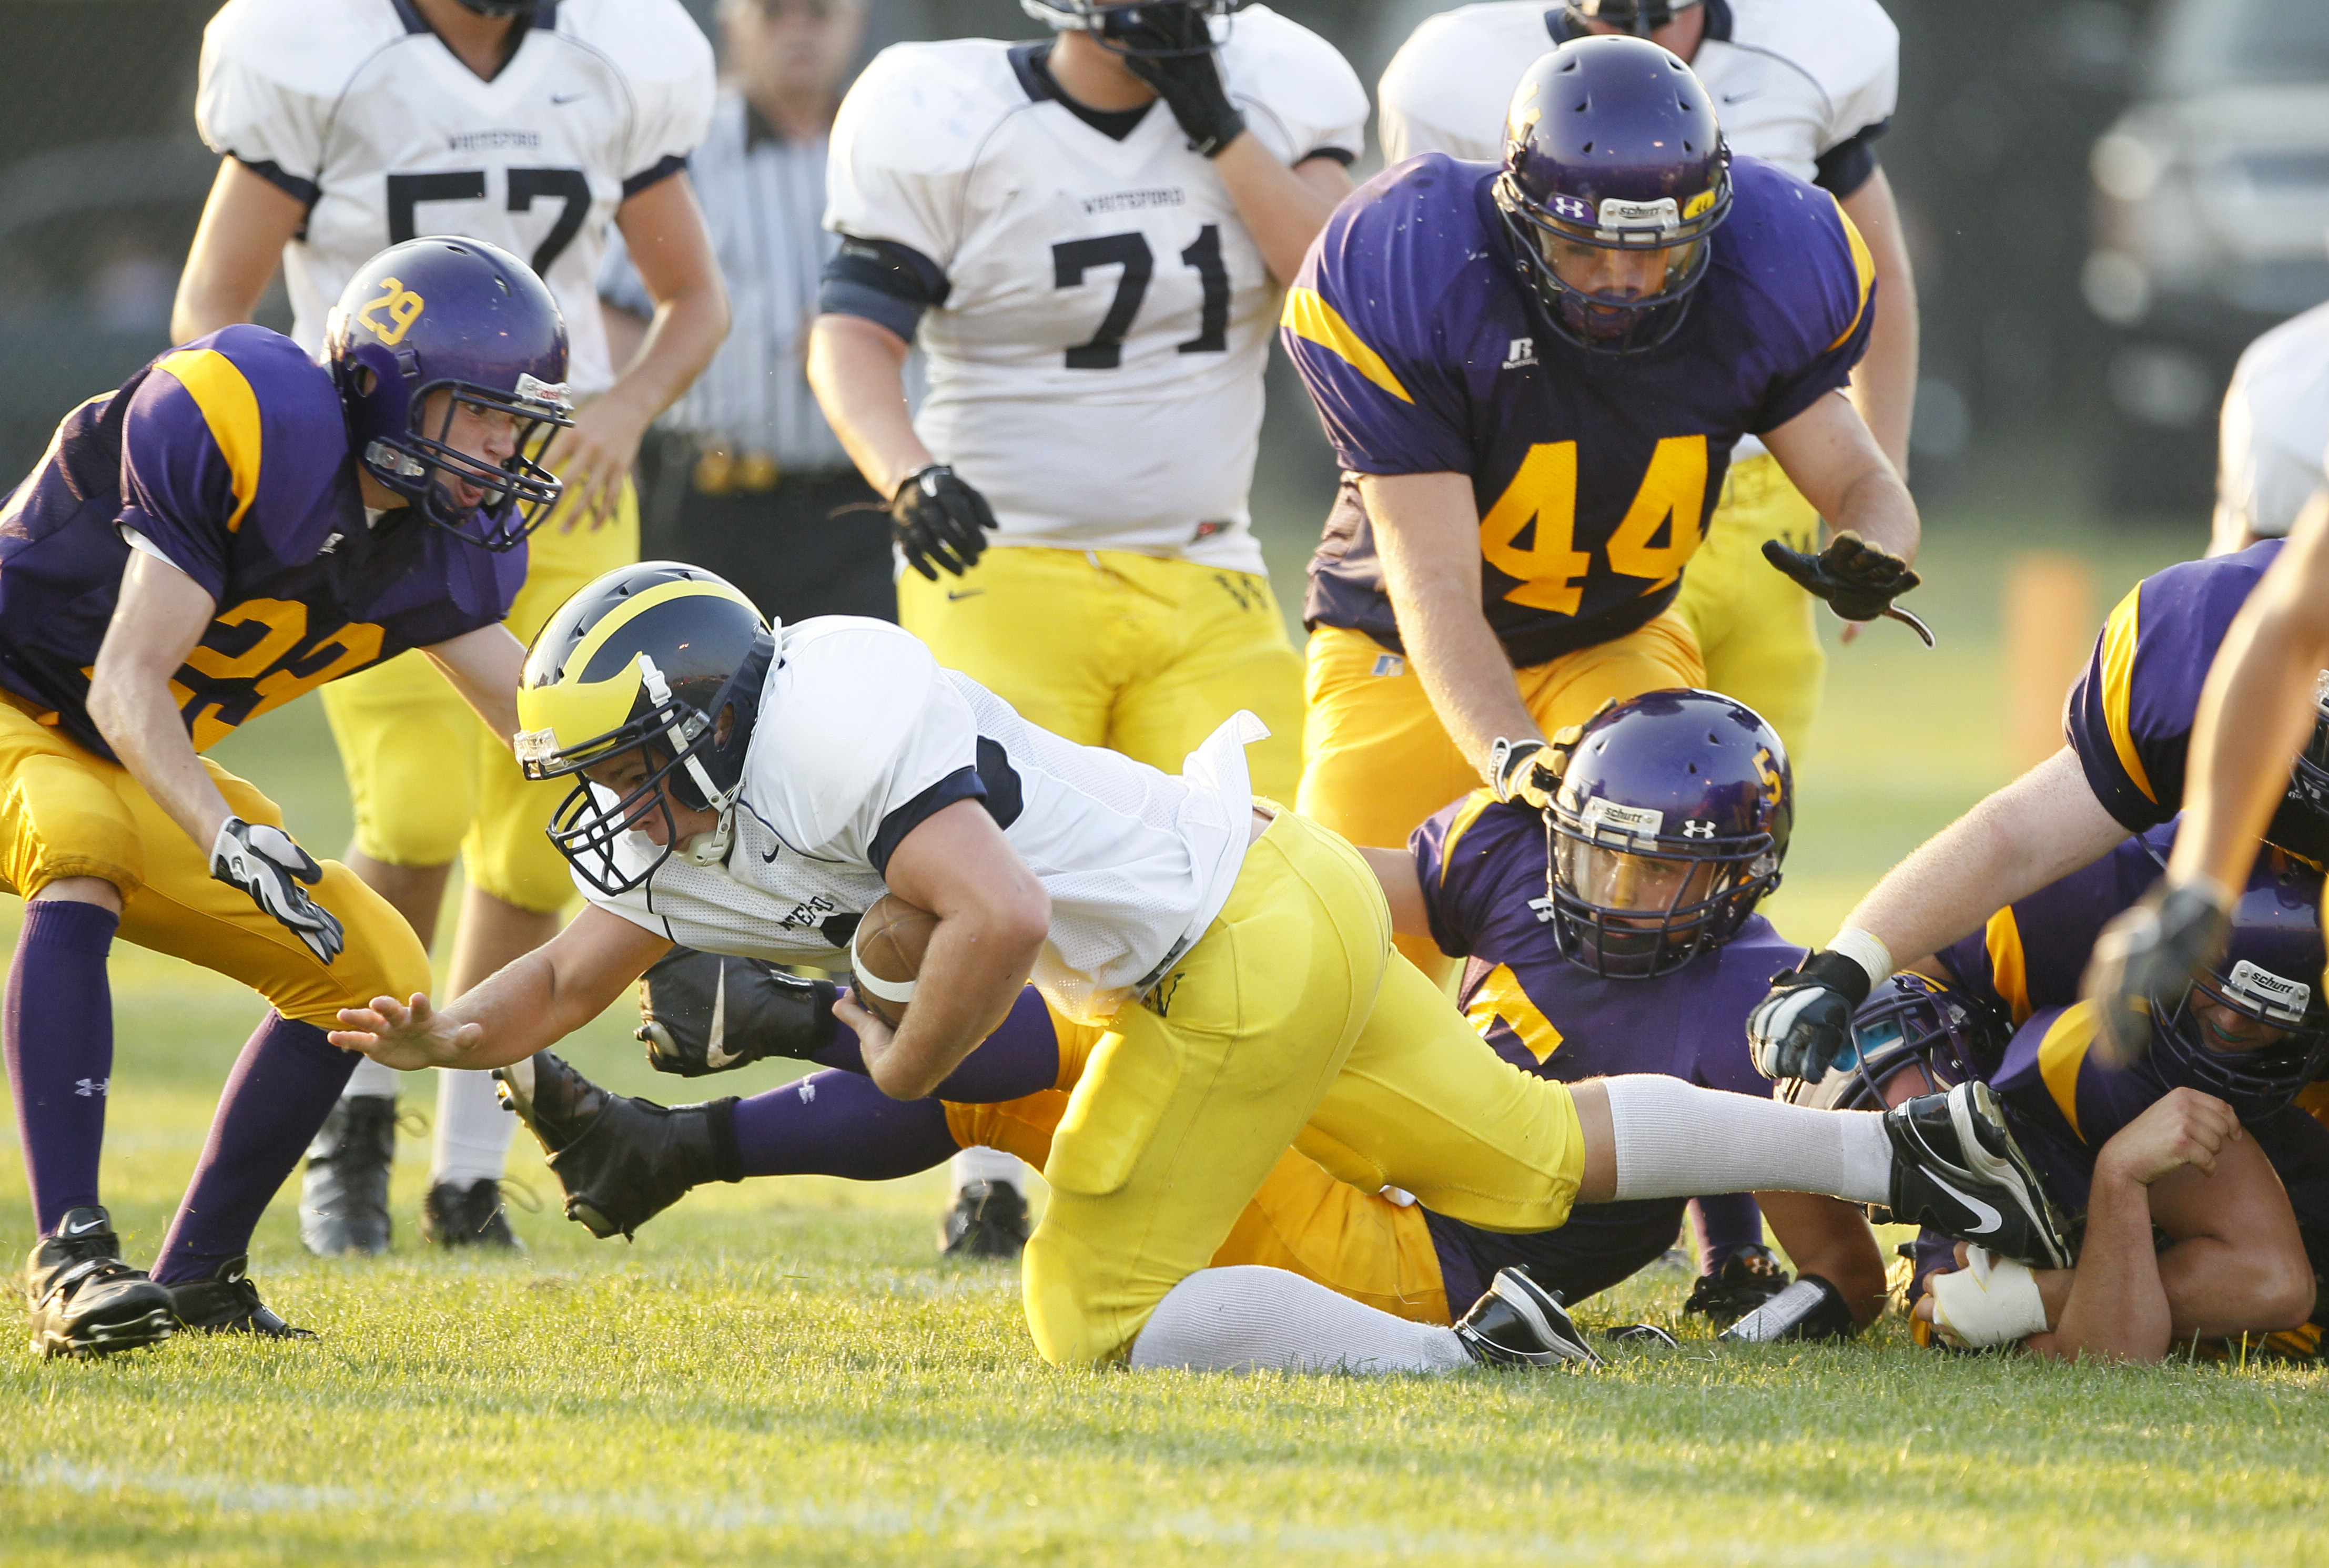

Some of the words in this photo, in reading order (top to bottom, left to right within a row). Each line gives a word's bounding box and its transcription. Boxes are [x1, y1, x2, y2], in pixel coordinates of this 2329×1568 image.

[356, 276, 424, 346] 29
[1052, 225, 1231, 369] 71
[1480, 434, 1708, 617] 44
[1751, 747, 1783, 807] 5
[1605, 807, 1643, 823] schutt
[2251, 972, 2294, 994] schutt
